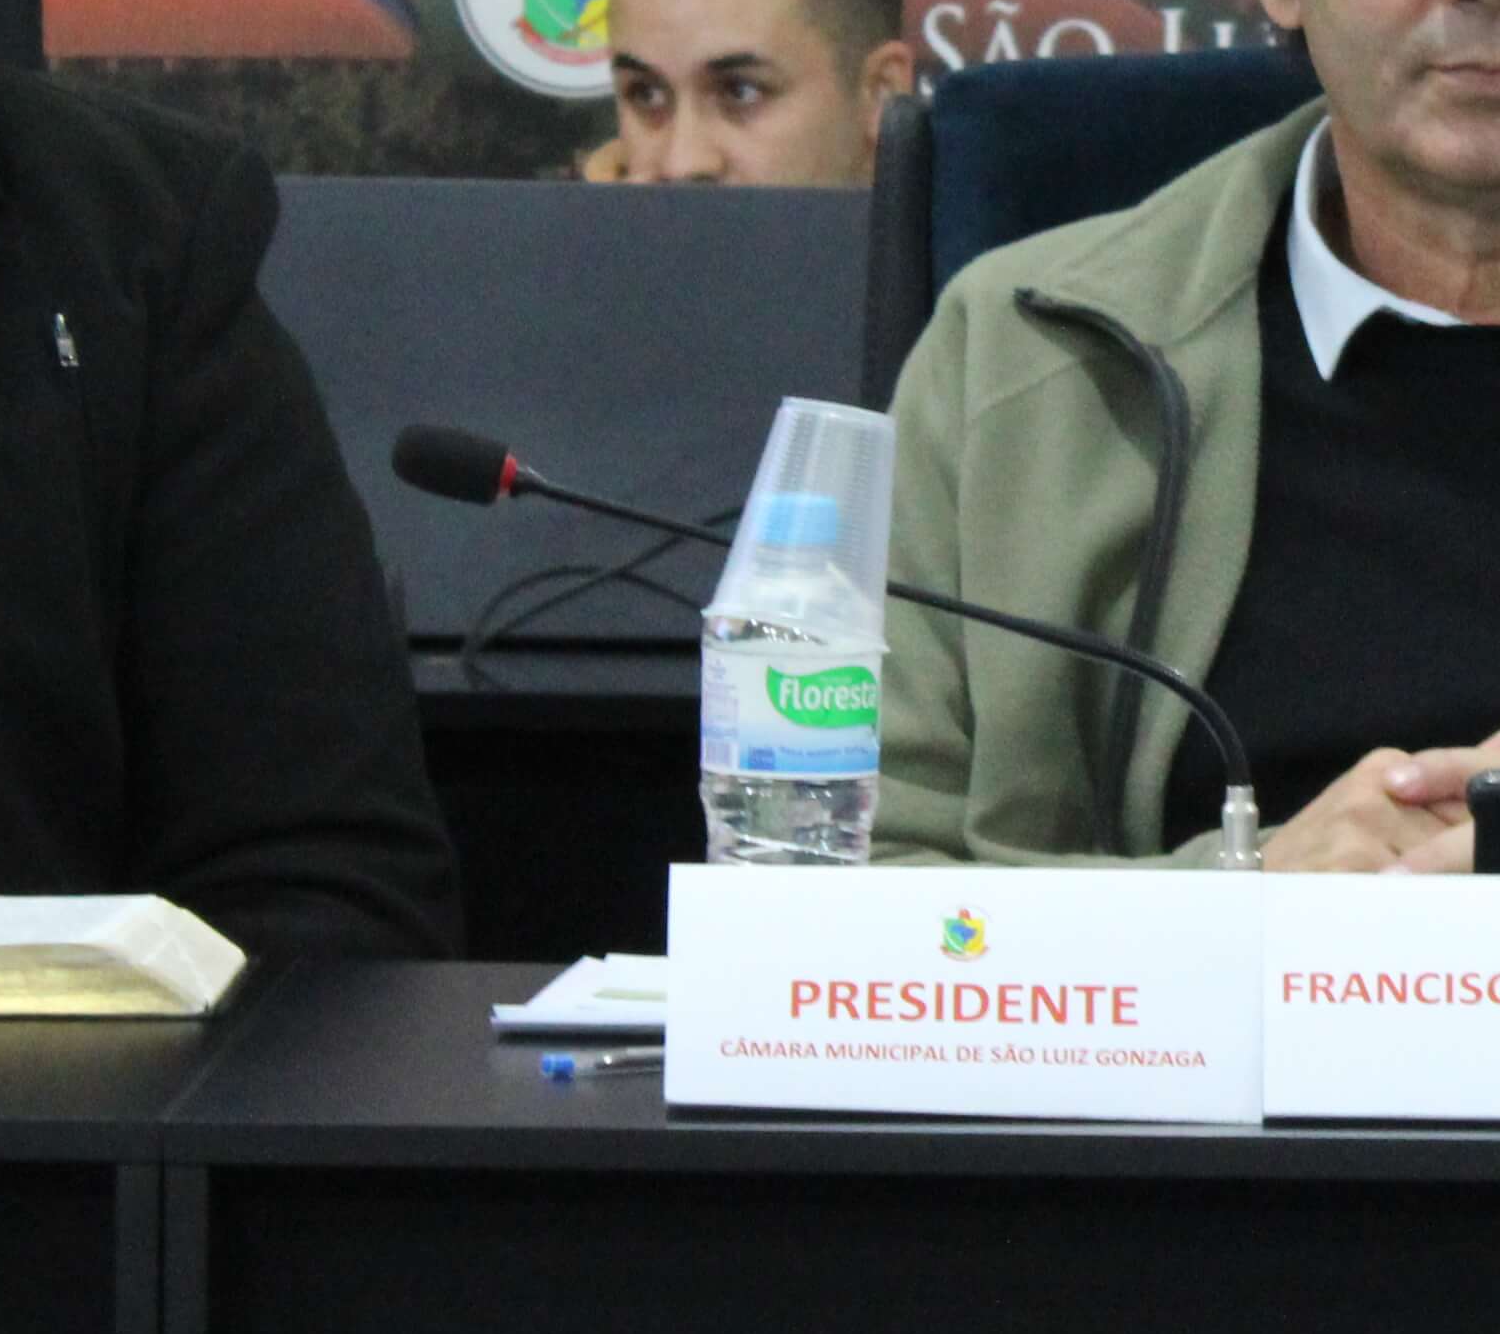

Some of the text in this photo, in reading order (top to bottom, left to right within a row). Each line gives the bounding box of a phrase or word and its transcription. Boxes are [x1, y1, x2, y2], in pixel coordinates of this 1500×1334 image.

[790, 979, 1140, 1027] PRESIDENTE
[720, 1037, 1207, 1068] CÂMARA MUNICIPAL DE SÃO LUIZ GONZAGA
